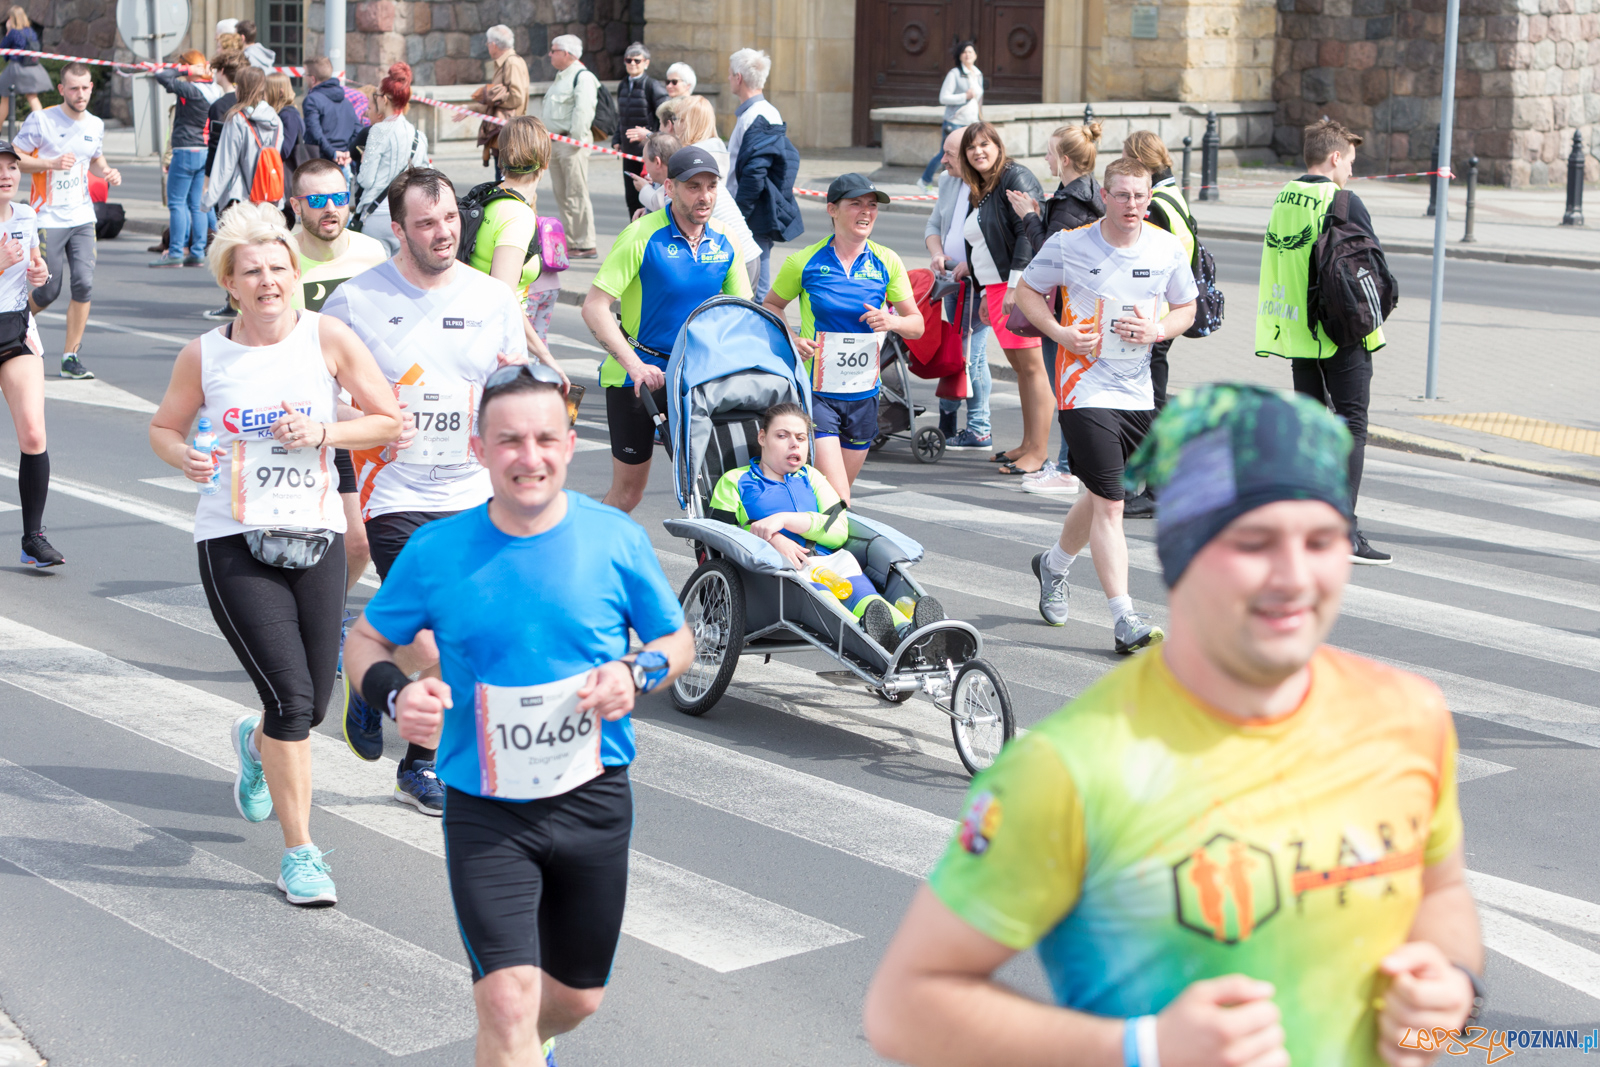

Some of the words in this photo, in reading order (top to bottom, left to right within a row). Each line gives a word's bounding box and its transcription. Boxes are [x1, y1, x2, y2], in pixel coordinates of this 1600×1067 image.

[388, 316, 404, 325] 4F
[836, 351, 869, 367] 360
[413, 411, 461, 432] 1788
[423, 435, 449, 443] Raphael
[256, 466, 316, 488] 9706
[496, 708, 592, 750] 10466
